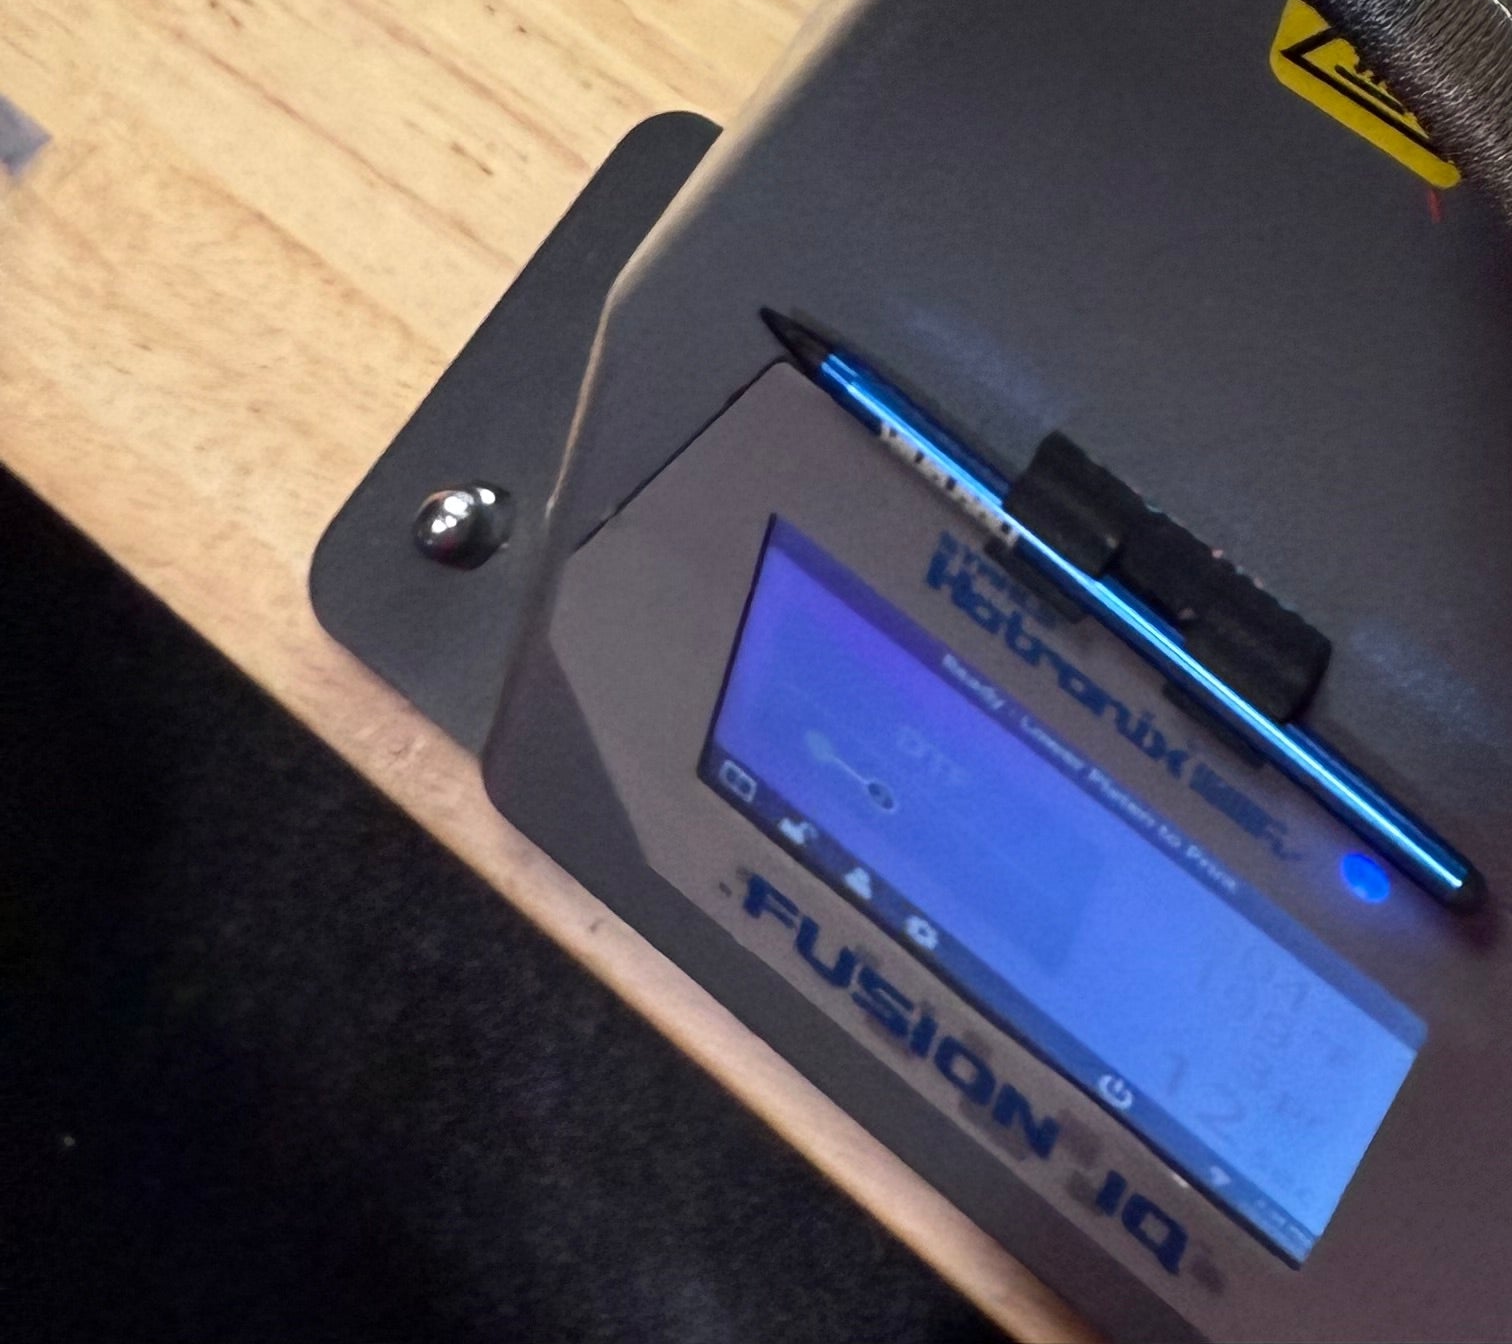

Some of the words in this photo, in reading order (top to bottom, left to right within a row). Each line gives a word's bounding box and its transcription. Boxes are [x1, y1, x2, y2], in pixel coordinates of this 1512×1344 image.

[925, 548, 1189, 781] Hotronix
[743, 872, 1062, 1161] FUSION
[1095, 1168, 1190, 1275] IQ
